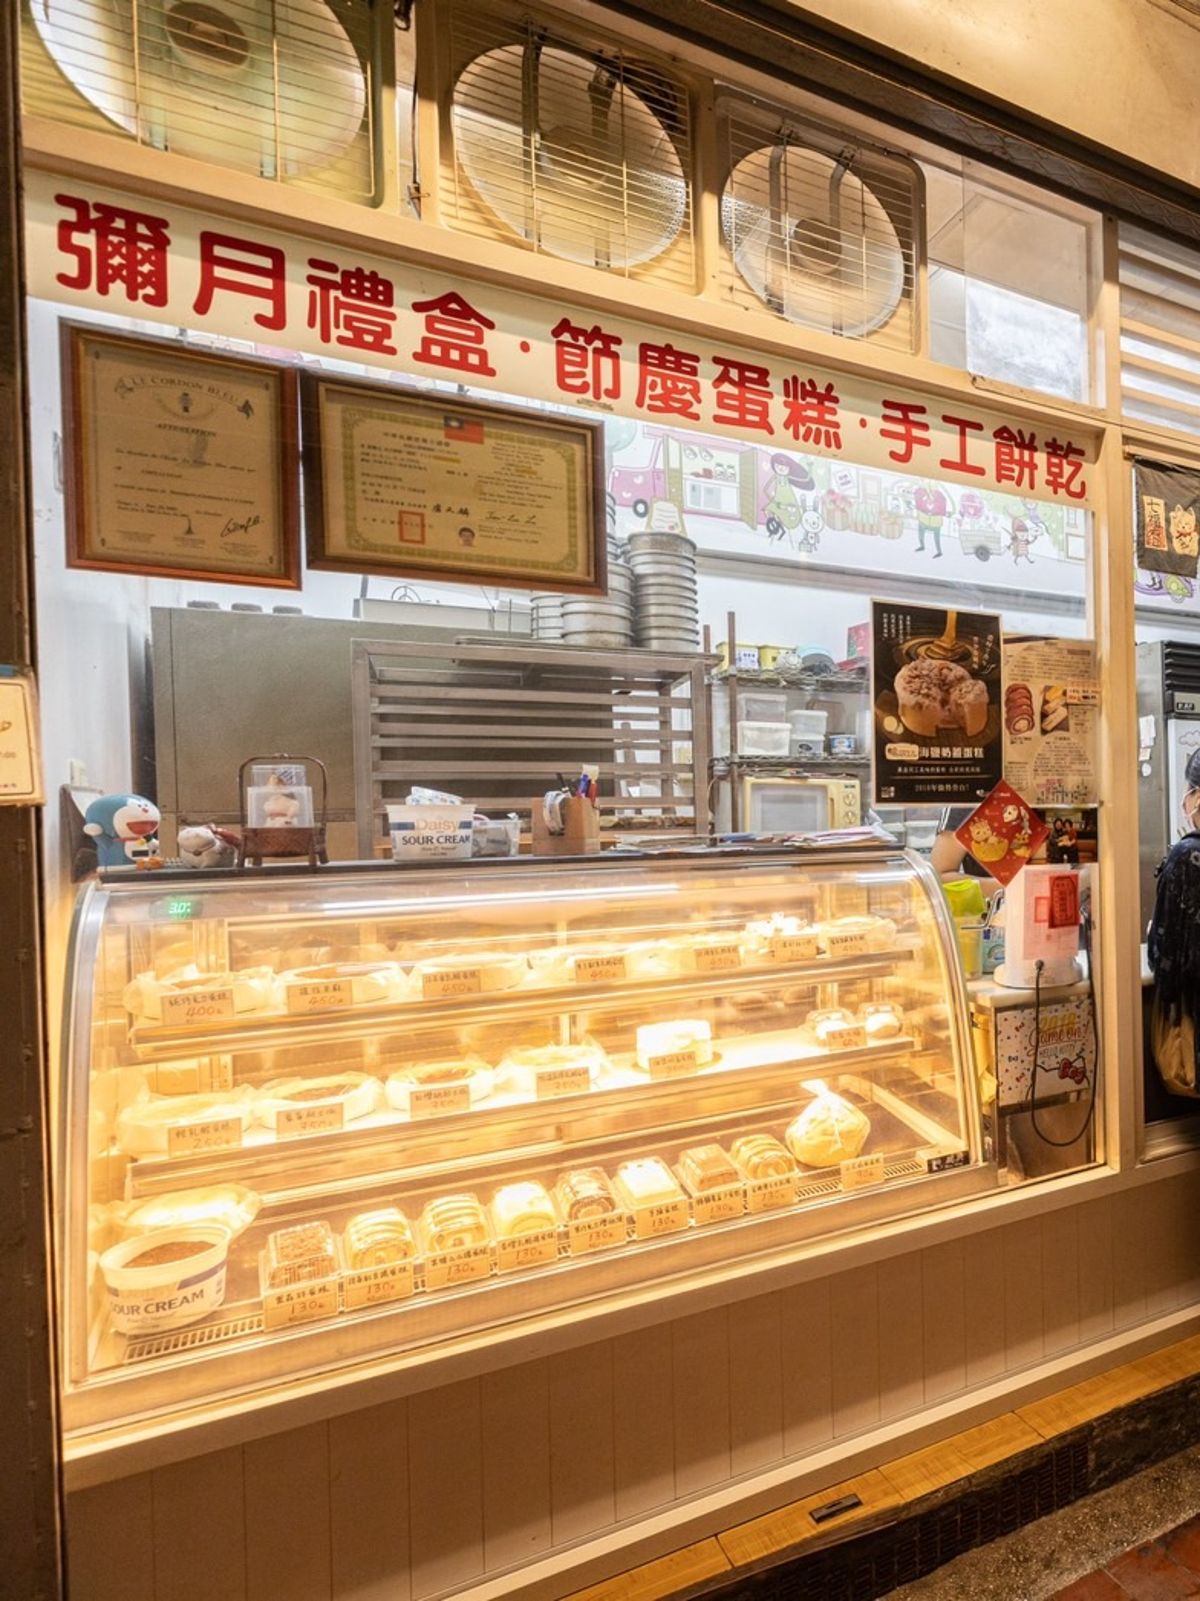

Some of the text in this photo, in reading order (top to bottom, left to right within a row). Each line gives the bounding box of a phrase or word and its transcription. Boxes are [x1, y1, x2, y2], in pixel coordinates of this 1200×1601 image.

[415, 818, 457, 833] Daisy
[402, 835, 434, 846] SOUR
[143, 1288, 205, 1314] CREAM
